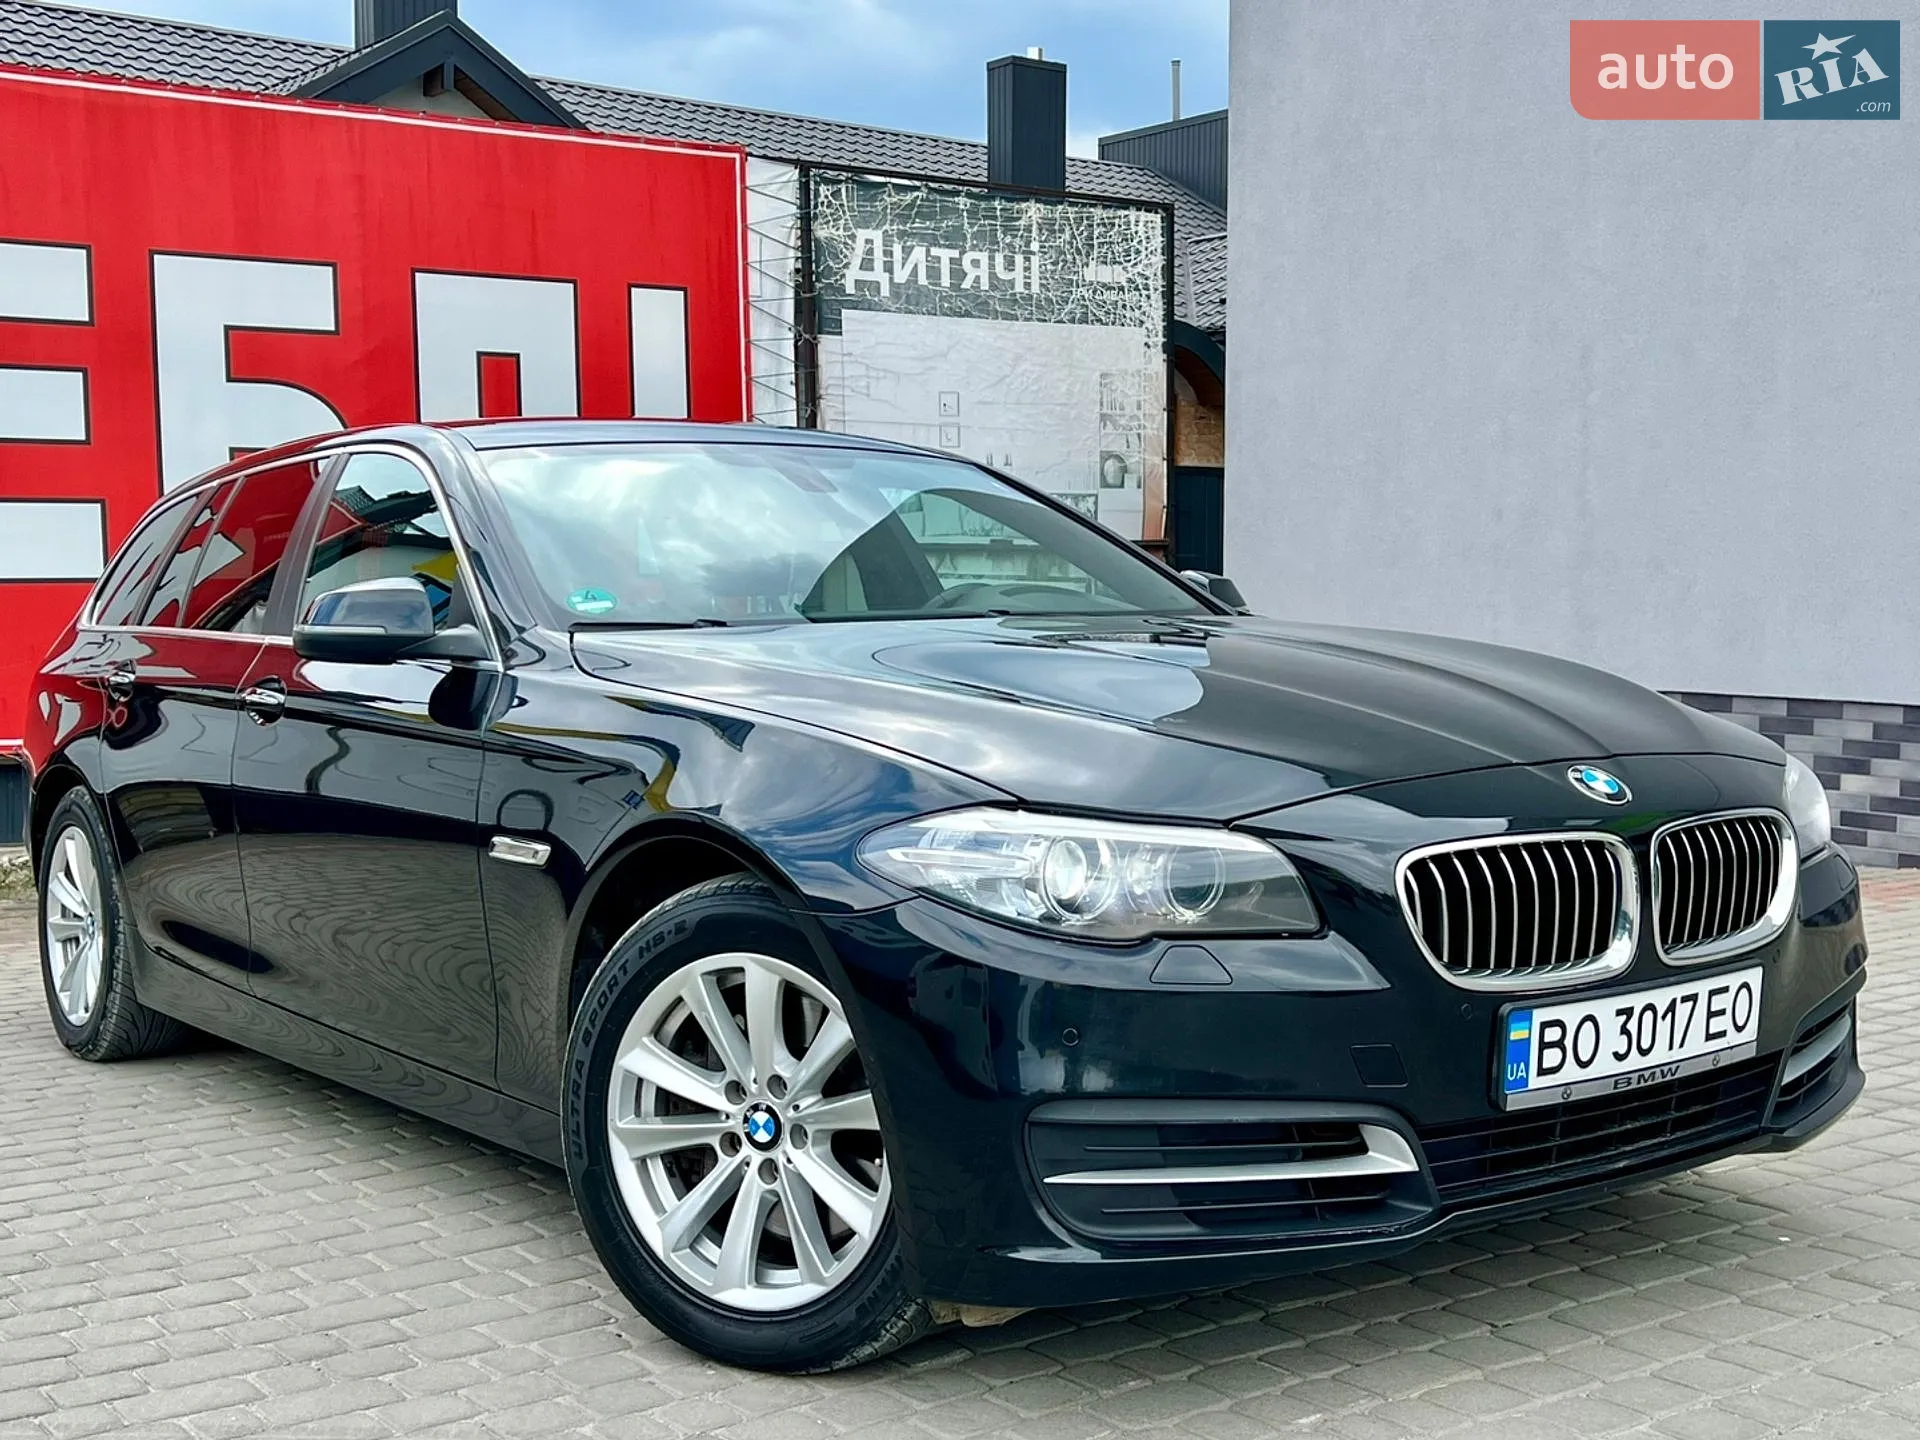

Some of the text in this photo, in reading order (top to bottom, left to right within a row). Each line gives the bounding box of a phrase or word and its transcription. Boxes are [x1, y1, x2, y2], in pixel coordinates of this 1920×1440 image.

[845, 228, 1041, 297] Дитячі
[568, 1058, 587, 1161] ULTRA
[580, 958, 632, 1046] SPORT
[1536, 980, 1754, 1078] BO 3017 EO
[1506, 1061, 1527, 1081] UA
[1612, 1064, 1681, 1091] BMW
